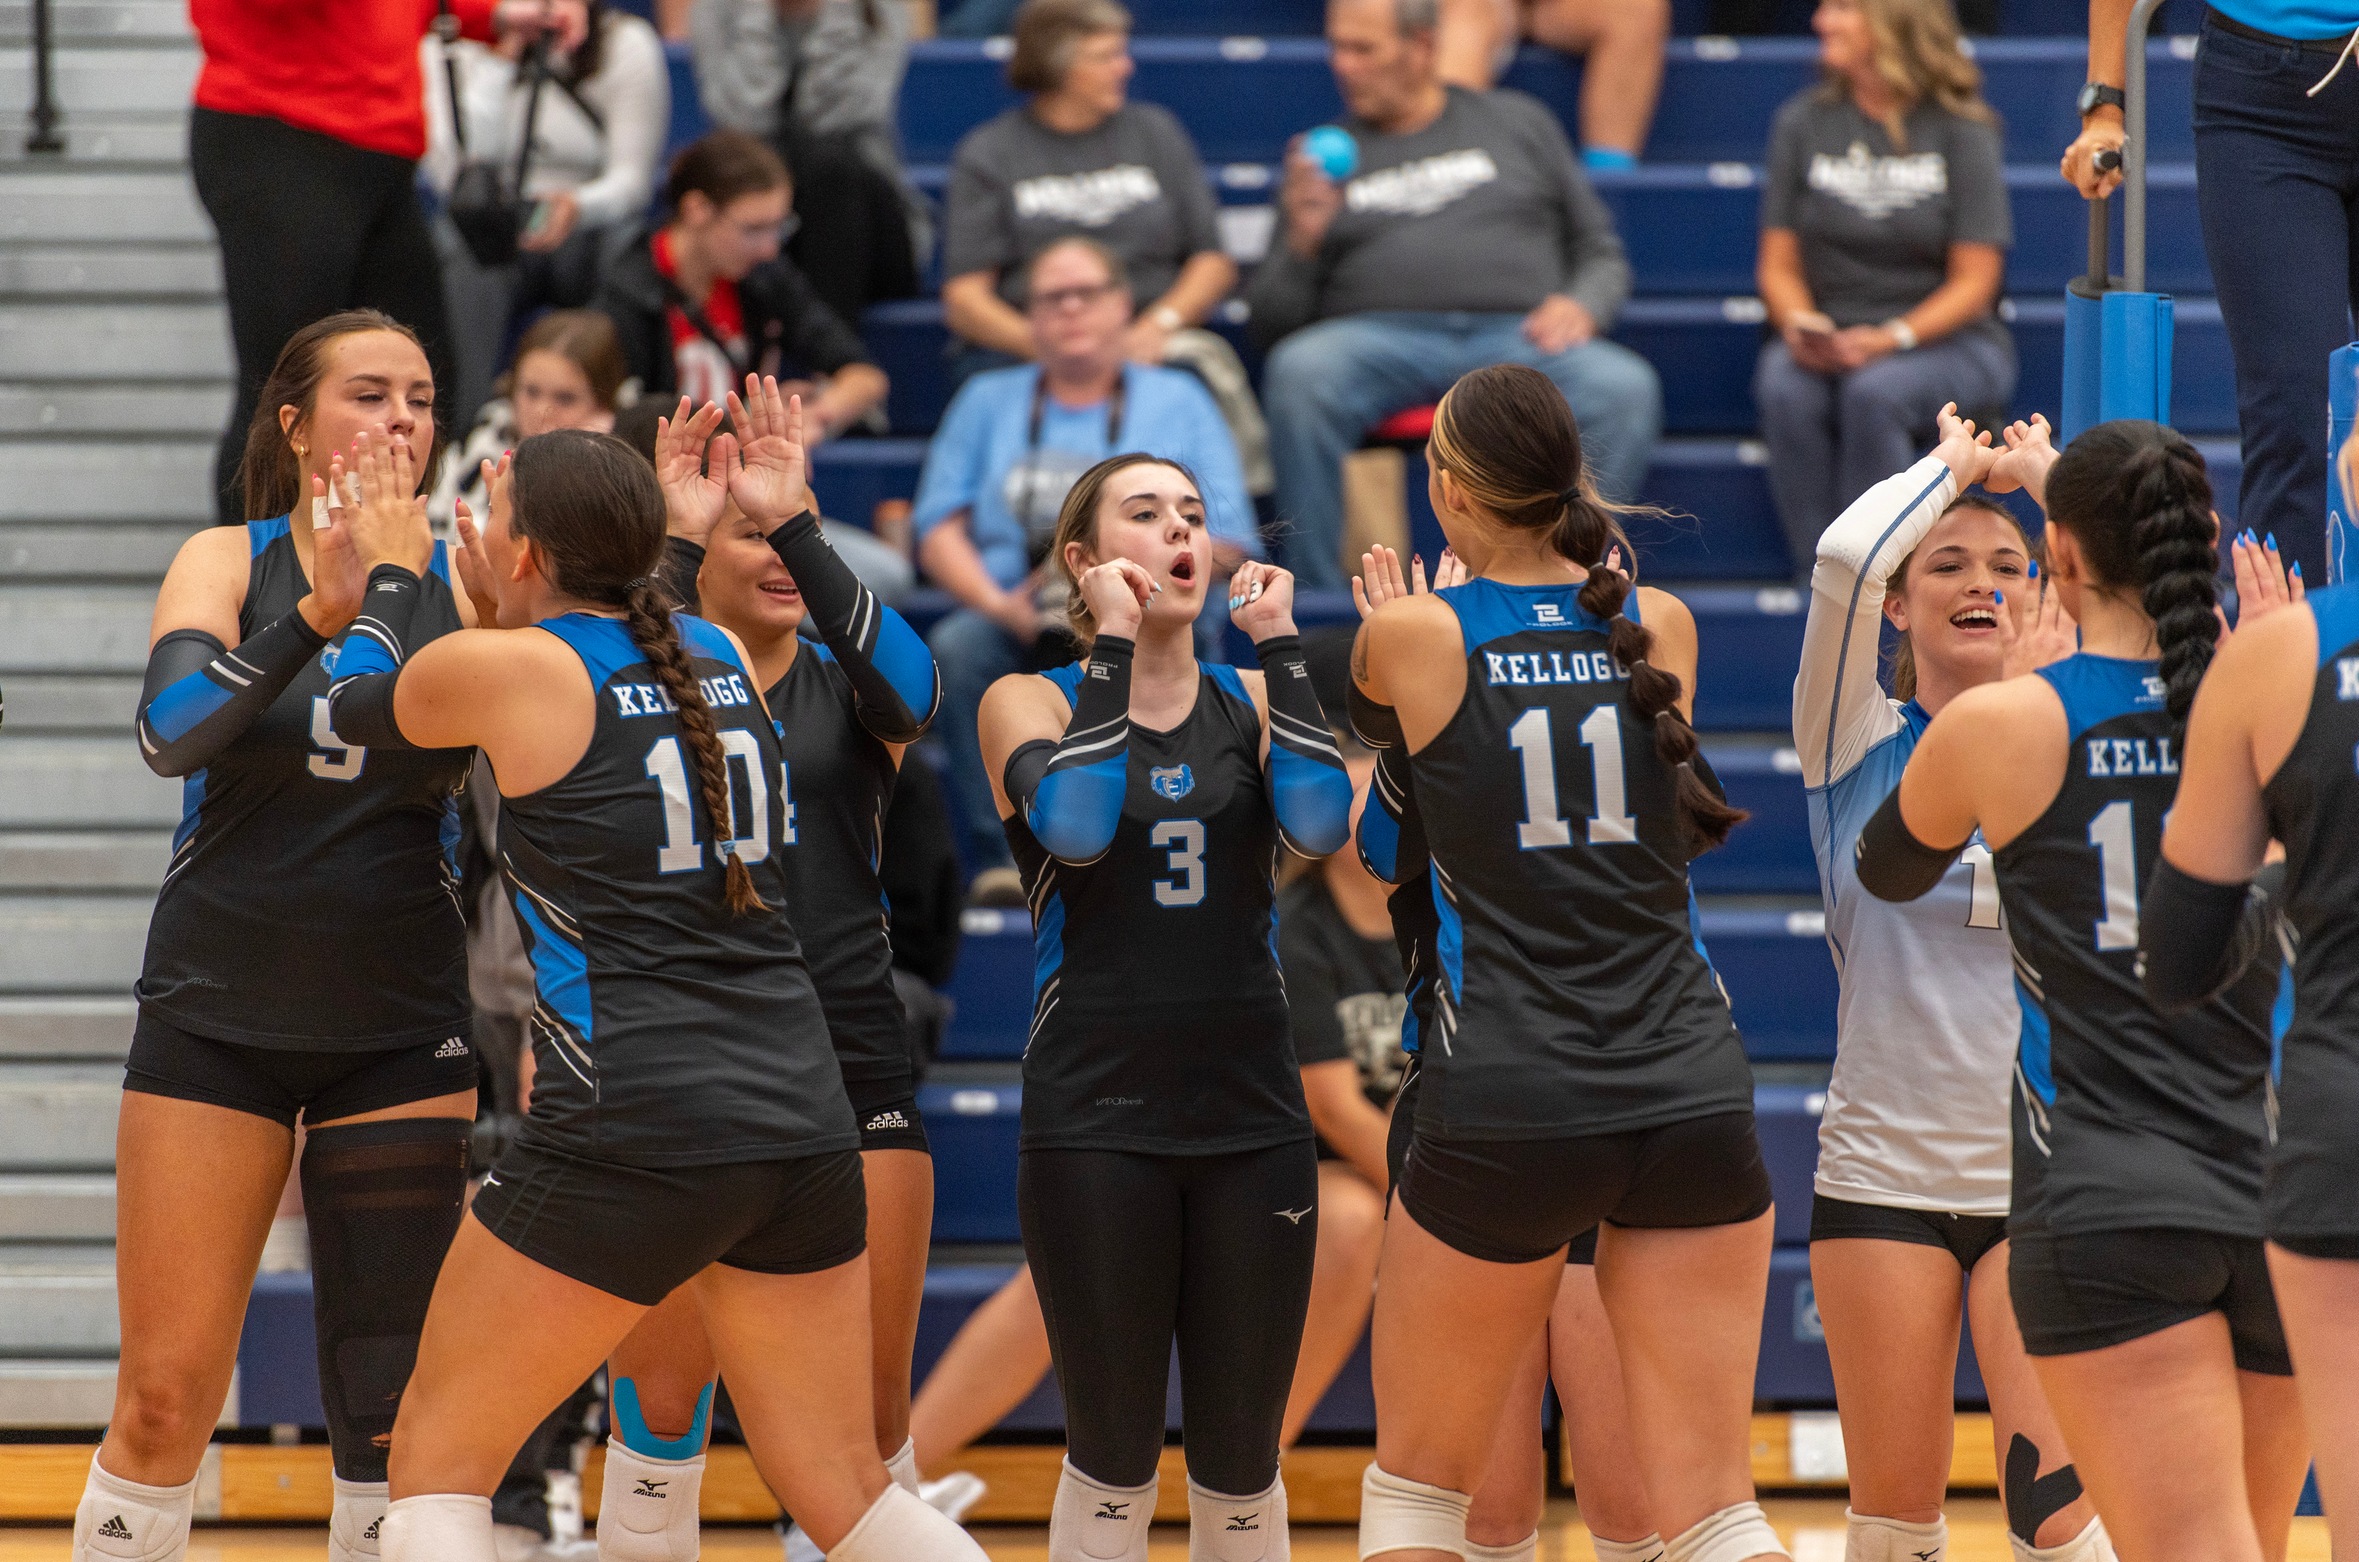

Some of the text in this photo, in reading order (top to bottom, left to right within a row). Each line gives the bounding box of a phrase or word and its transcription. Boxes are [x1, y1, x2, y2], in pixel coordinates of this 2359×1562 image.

[306, 694, 369, 784] 5
[609, 673, 751, 719] KELOGG
[643, 726, 771, 875] 10
[1507, 703, 1640, 852] 11
[1149, 817, 1208, 908] 3
[2087, 800, 2173, 952] 1
[434, 1045, 469, 1058] adidas
[866, 1117, 909, 1130] adidas
[98, 1527, 133, 1540] adidas
